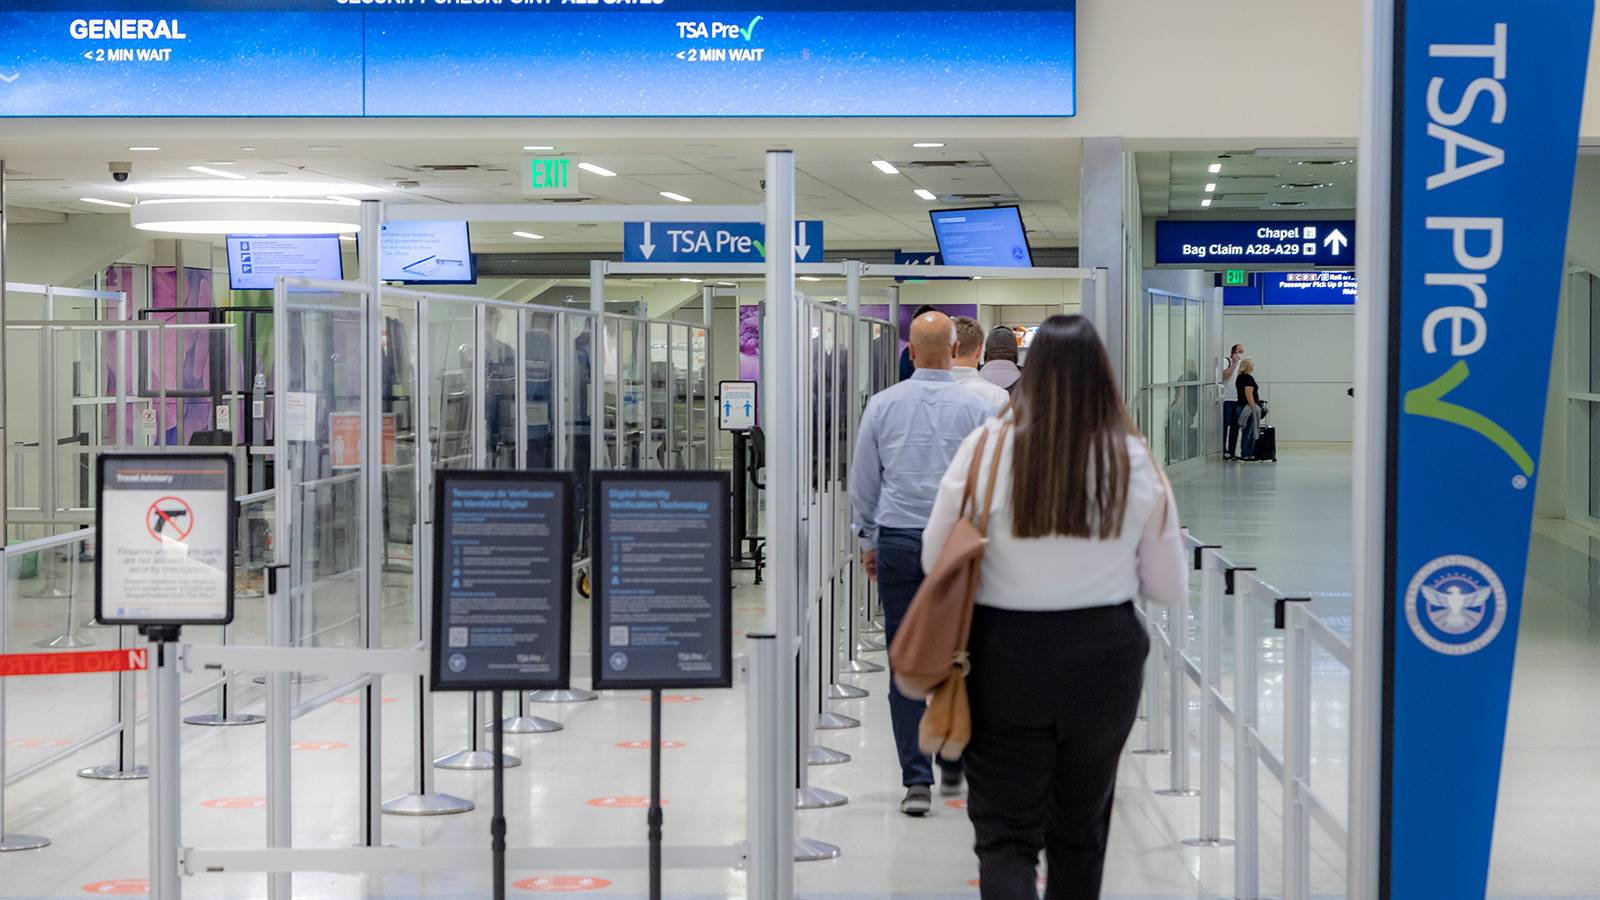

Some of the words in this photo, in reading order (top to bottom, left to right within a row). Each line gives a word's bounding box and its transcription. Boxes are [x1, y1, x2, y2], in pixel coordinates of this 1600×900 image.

[69, 18, 187, 40] GENERAL
[676, 21, 708, 39] TSA
[711, 22, 740, 39] Pre
[95, 49, 105, 62] 2
[107, 49, 134, 62] MIN
[136, 48, 172, 62] WAIT
[688, 49, 697, 62] 2
[700, 49, 726, 62] MIN
[728, 48, 765, 62] WAIT
[1426, 22, 1507, 190] TSA
[532, 159, 570, 189] EXIT
[667, 230, 712, 253] TSA
[716, 230, 751, 253] Pre
[1257, 227, 1300, 240] Chapel
[1183, 244, 1206, 257] Bag
[1209, 243, 1243, 256] Claim
[1245, 244, 1300, 256] A28-A29
[1226, 269, 1245, 284] EXIT
[1279, 281, 1312, 289] Passenger
[1327, 281, 1336, 289] Up
[1421, 216, 1503, 357] Pre
[116, 473, 139, 483] Travel
[141, 473, 173, 484] Advisory
[128, 650, 146, 669] N
